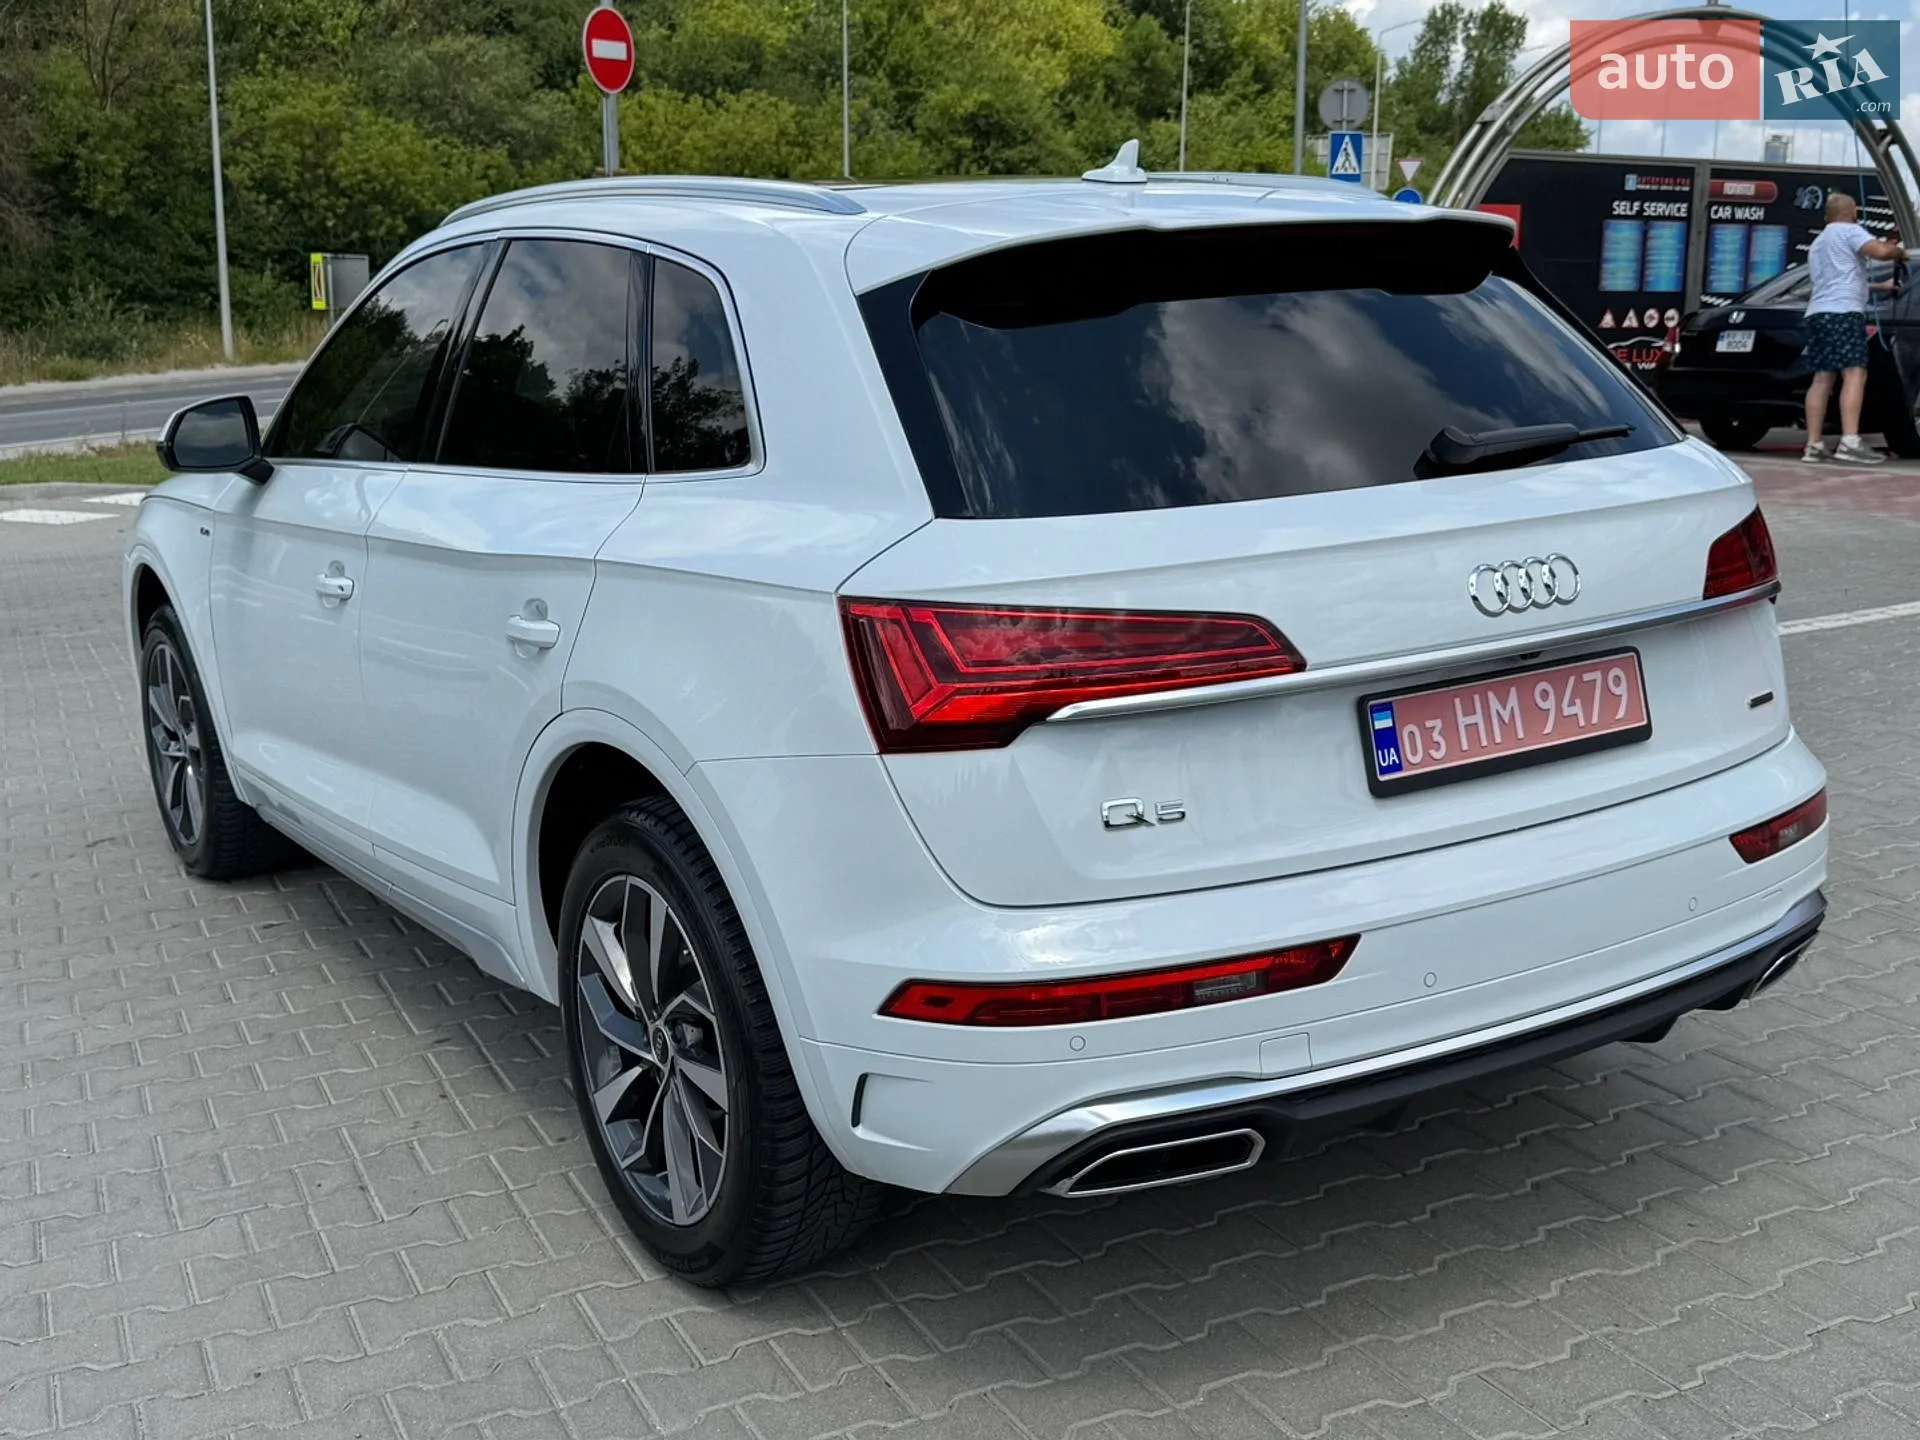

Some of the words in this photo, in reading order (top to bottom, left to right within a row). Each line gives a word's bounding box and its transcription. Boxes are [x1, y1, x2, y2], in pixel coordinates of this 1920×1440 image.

[1612, 200, 1640, 216] SELF
[1642, 201, 1688, 217] SERVICE
[1710, 205, 1732, 219] CAR
[1734, 207, 1764, 220] WASH
[1402, 718, 1447, 765] 03
[1453, 687, 1524, 751] HM
[1533, 667, 1628, 735] 9479
[1378, 747, 1399, 766] UA
[1101, 797, 1186, 831] Q5
